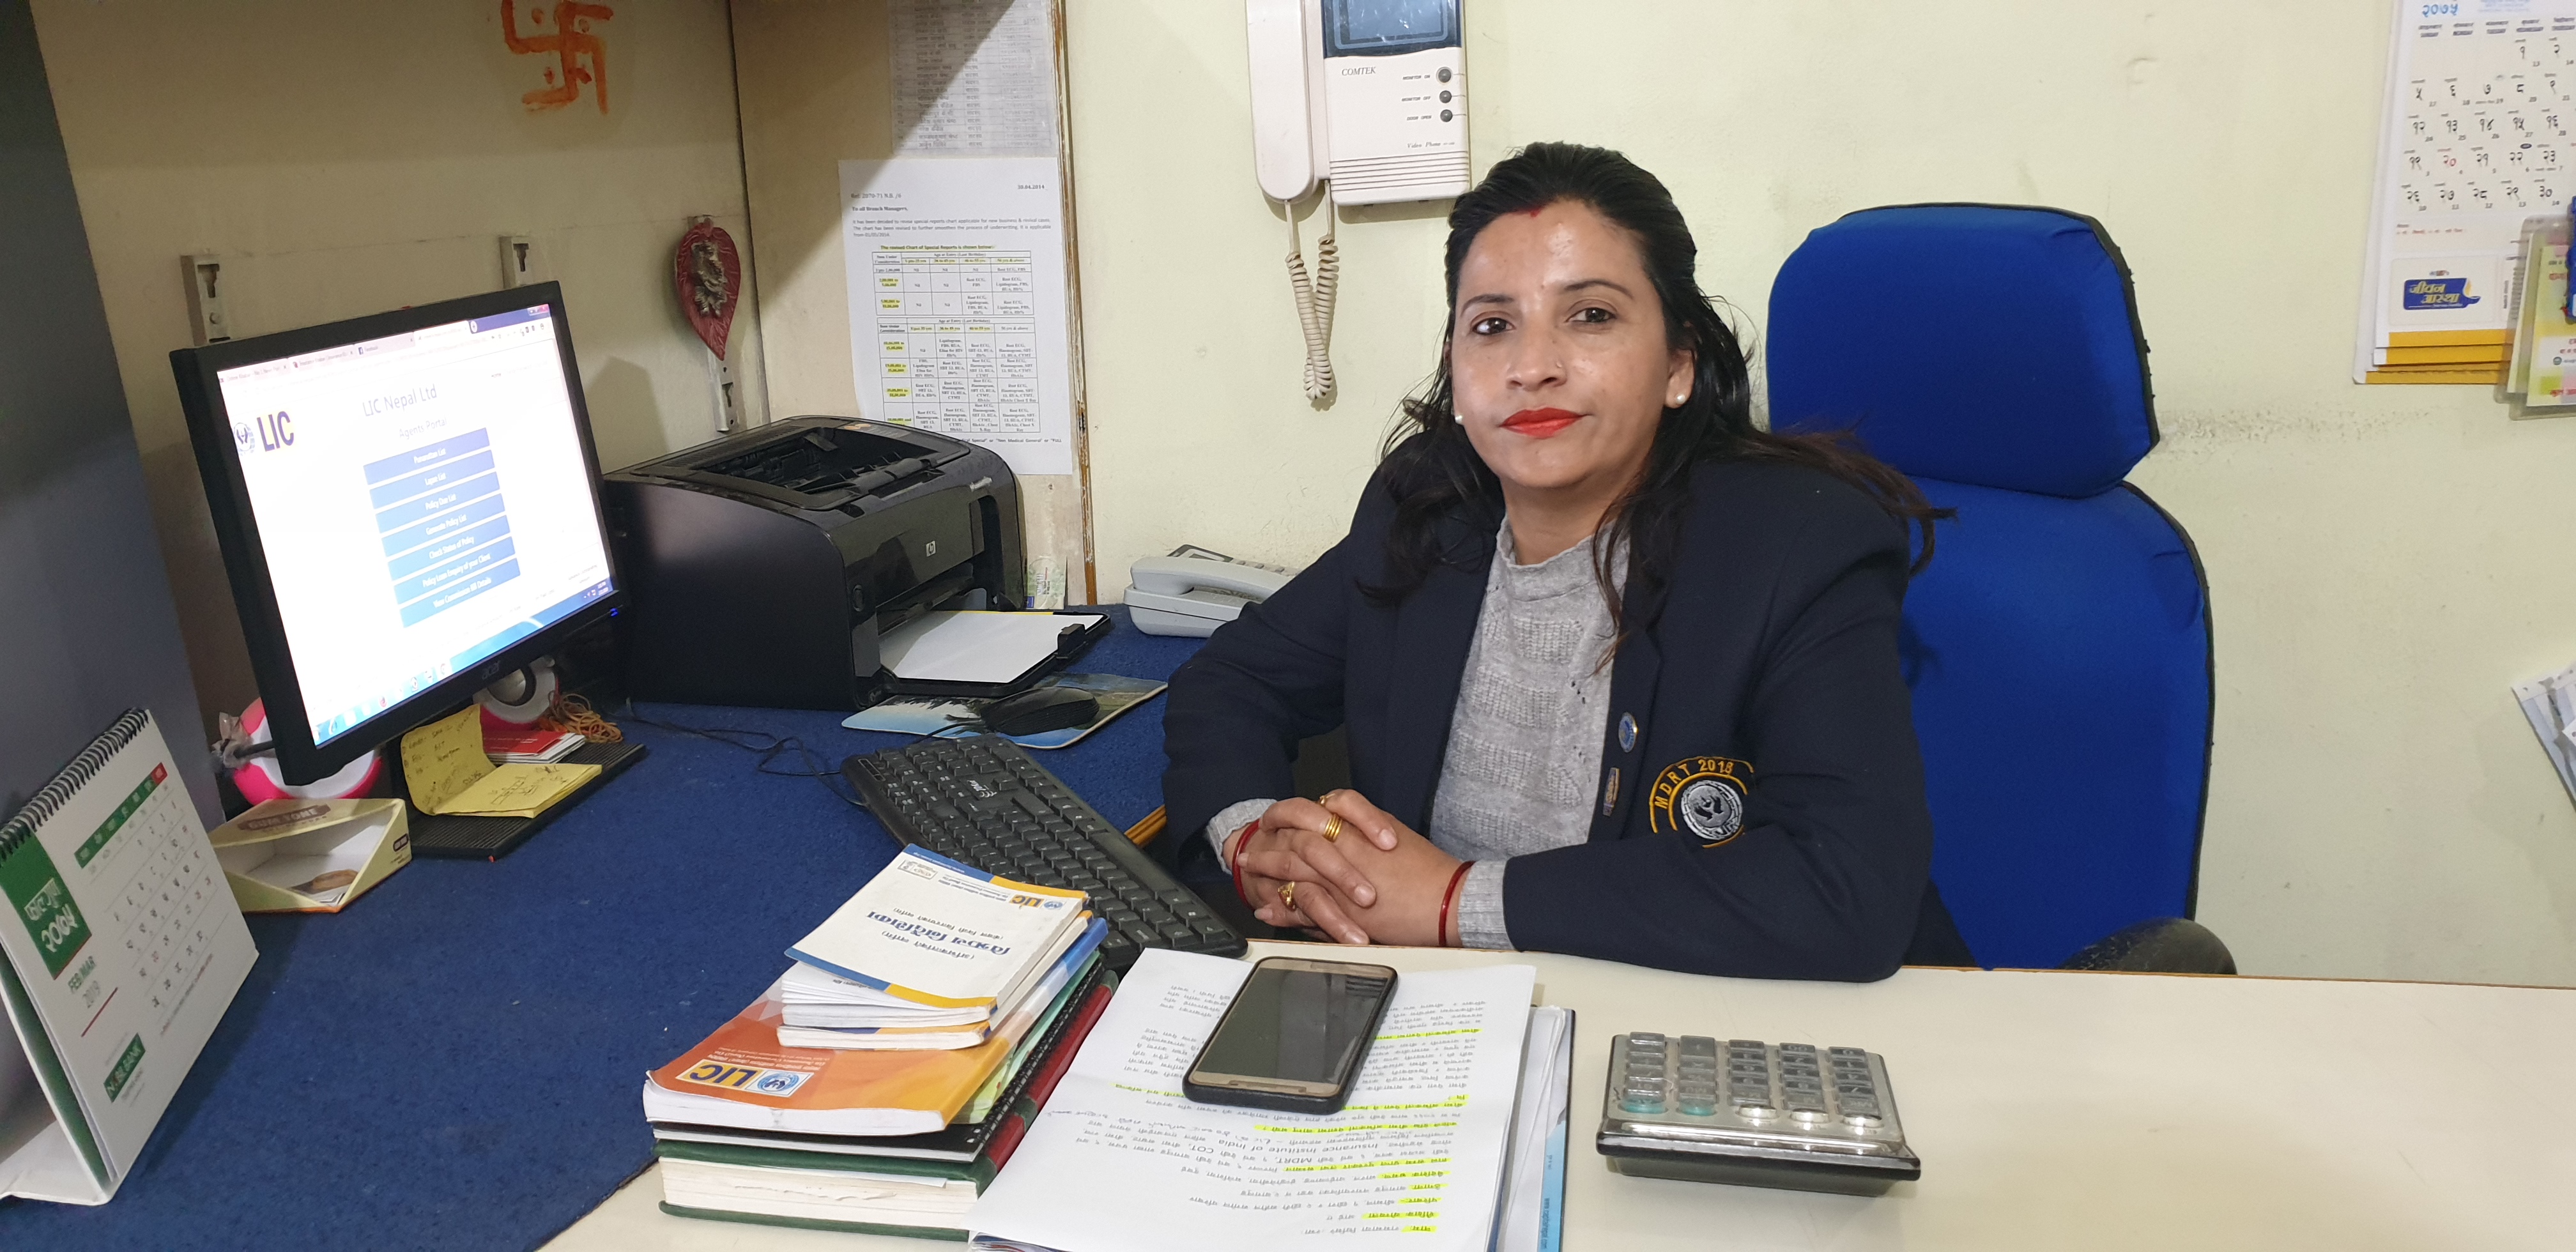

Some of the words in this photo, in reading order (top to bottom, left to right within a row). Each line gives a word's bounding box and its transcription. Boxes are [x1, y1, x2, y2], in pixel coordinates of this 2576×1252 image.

[1342, 66, 1376, 76] COMTEK
[362, 397, 382, 417] LIC
[383, 388, 418, 411] Nepal
[419, 384, 438, 402] Ltd
[256, 411, 295, 452] LIC
[399, 424, 425, 440] Agents
[426, 416, 447, 430] Portal
[425, 498, 439, 511] Policy
[445, 517, 459, 529] Policy
[461, 535, 475, 547] Policy
[422, 576, 437, 588] Policy
[478, 553, 491, 563] Client
[1654, 763, 1690, 809] MDRT
[1698, 760, 1735, 775] 2018
[1011, 894, 1042, 908] LIC
[689, 1064, 758, 1087] LIC
[1218, 1140, 1246, 1150] India
[1322, 1143, 1378, 1152] Insurance
